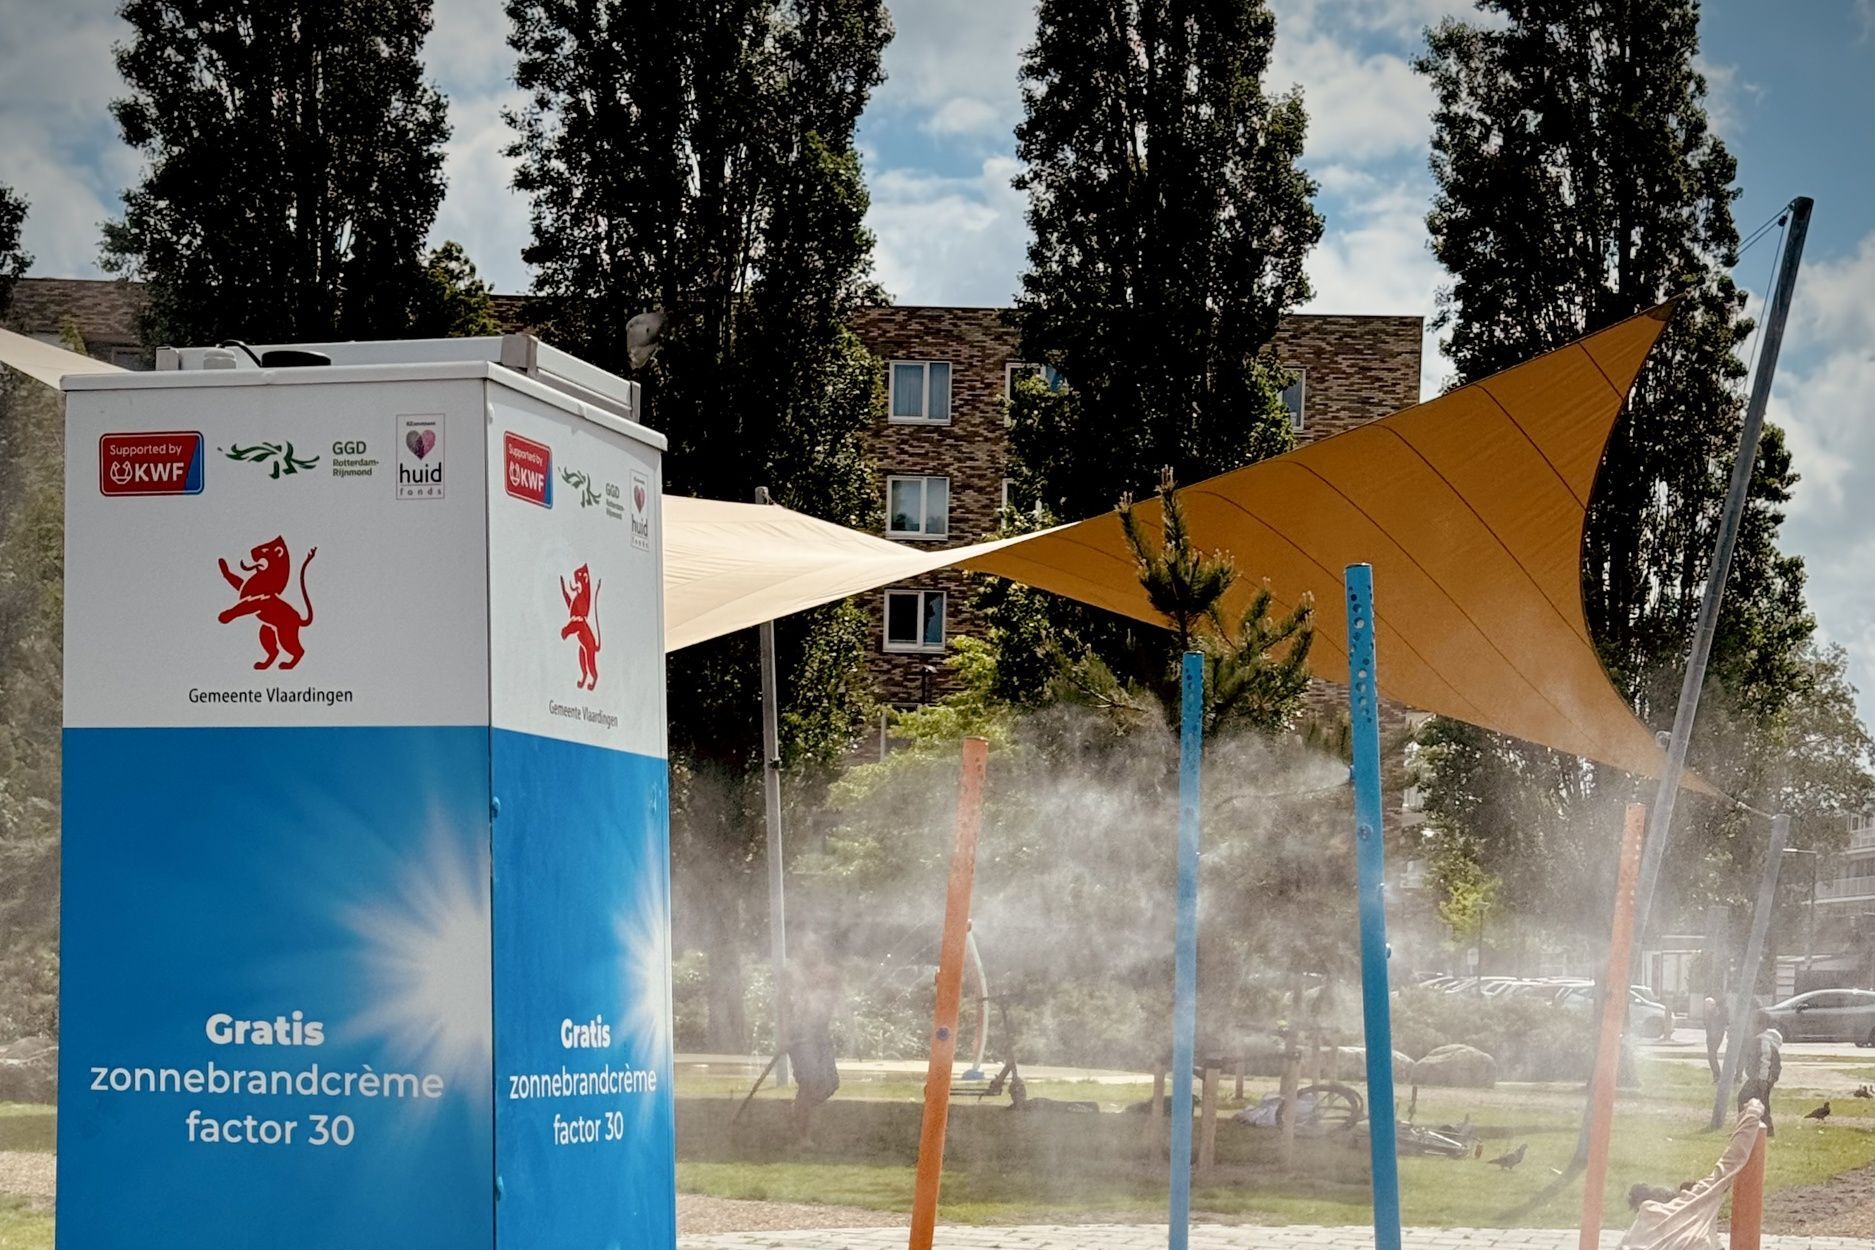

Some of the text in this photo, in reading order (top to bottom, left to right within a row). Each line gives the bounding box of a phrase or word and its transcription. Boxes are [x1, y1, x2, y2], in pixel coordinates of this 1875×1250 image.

[110, 443, 183, 457] Supported by
[332, 441, 367, 455] GGD
[134, 462, 185, 482] KWF
[332, 468, 372, 478] Rijnmond
[399, 462, 442, 483] huid
[520, 467, 545, 493] KWF
[605, 482, 620, 499] GGD
[631, 513, 648, 537] huid
[188, 686, 353, 706] Gemeente Vlaardingen
[548, 699, 619, 729] Gemeente Vlaardingen
[206, 1010, 325, 1046] Gratis
[560, 1014, 611, 1049] Gratis
[89, 1061, 445, 1098] zonnebrandcrème
[509, 1063, 657, 1099] zonnebrandcrème
[186, 1110, 355, 1146] factor 30
[553, 1111, 624, 1146] factor 30
